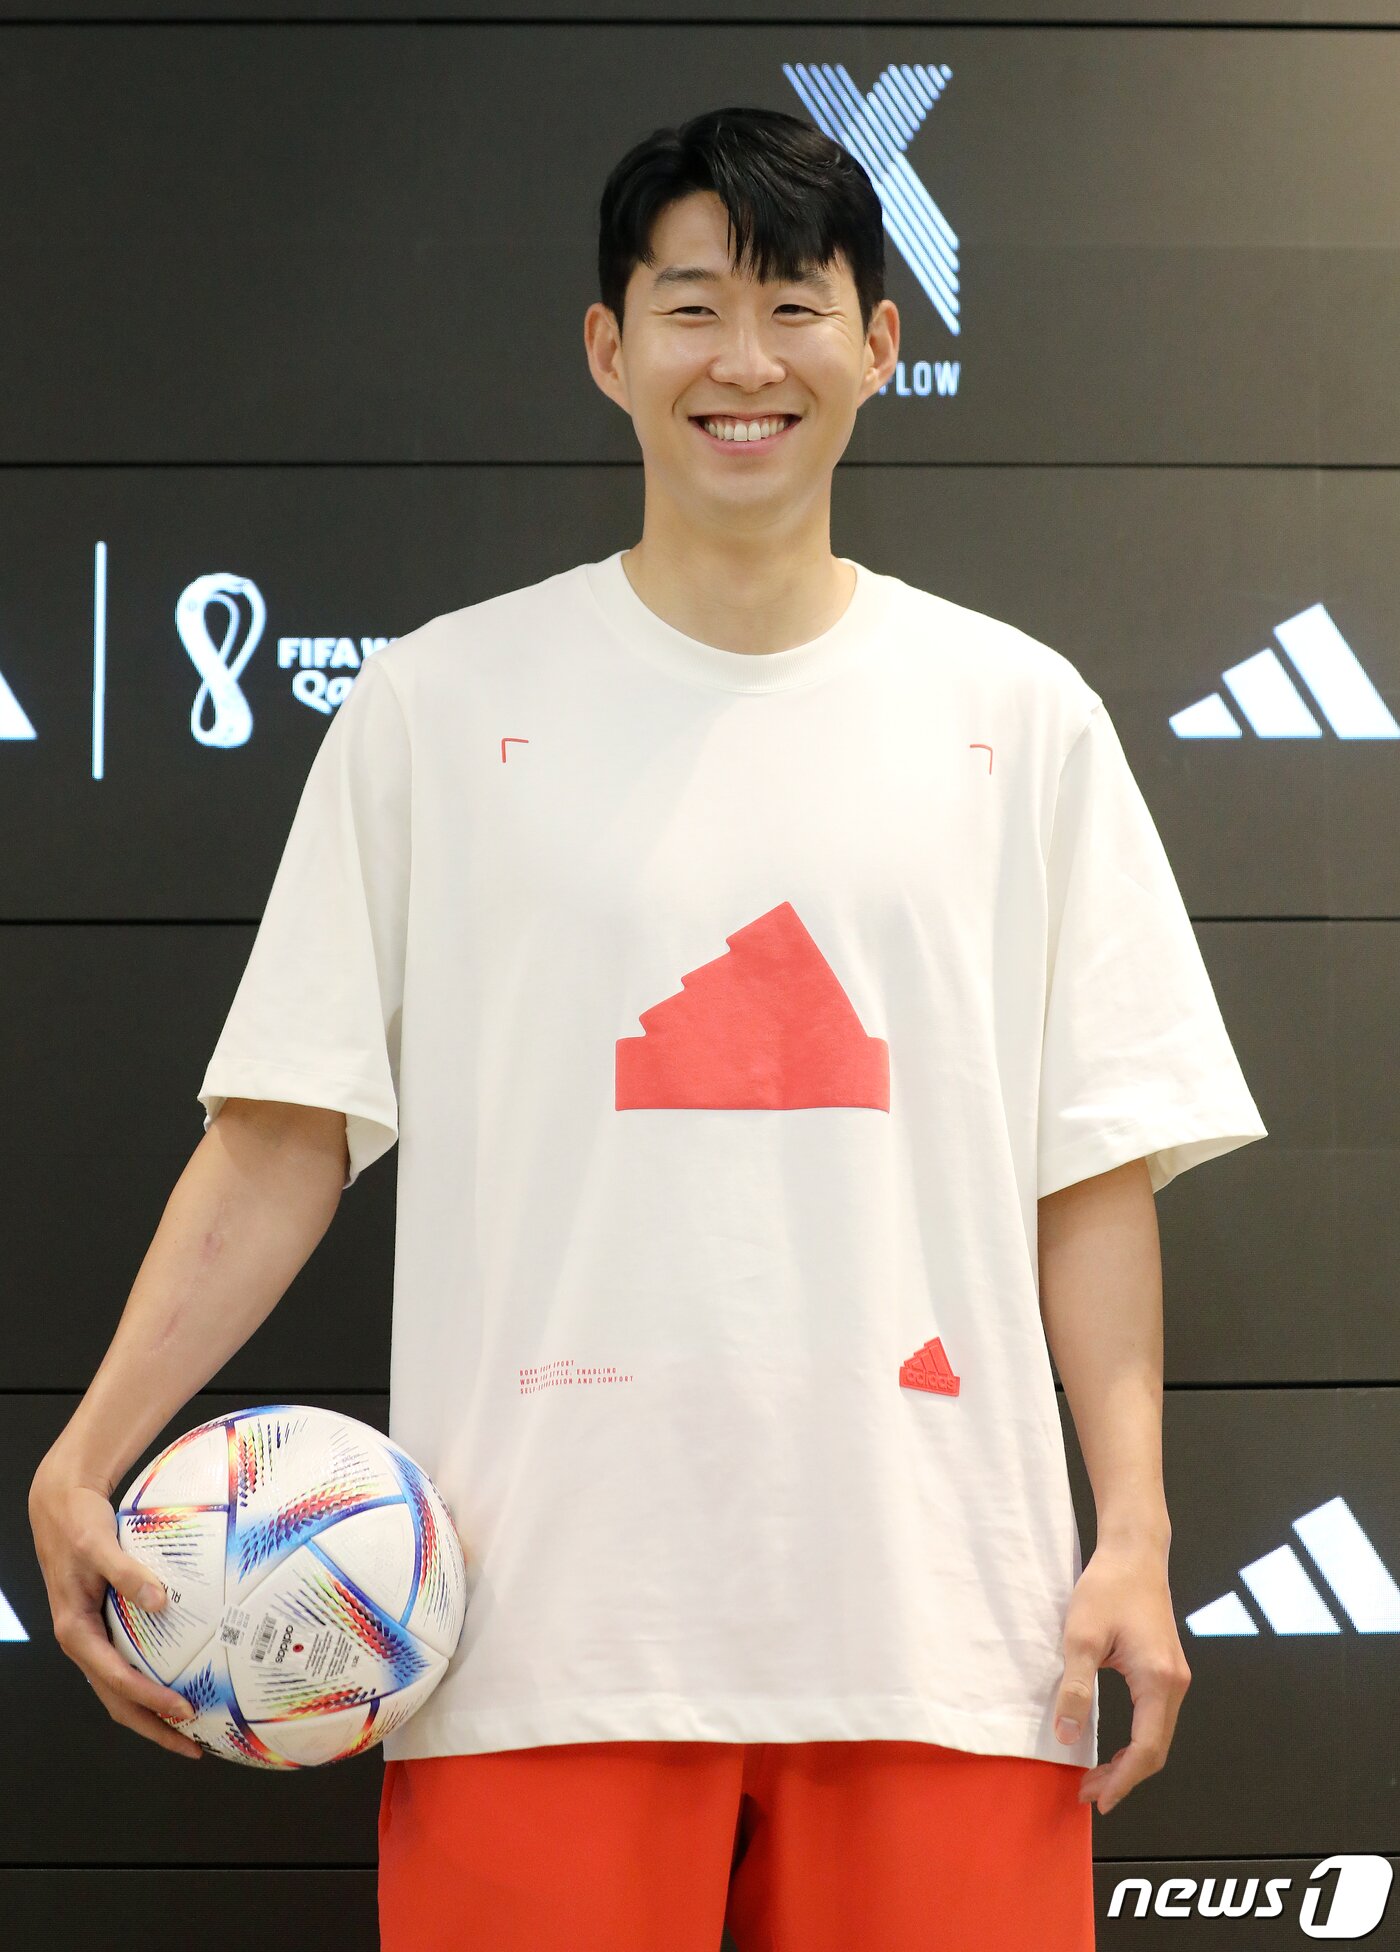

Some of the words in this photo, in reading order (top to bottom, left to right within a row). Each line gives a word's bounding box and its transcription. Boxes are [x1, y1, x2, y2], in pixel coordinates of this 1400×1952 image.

[878, 361, 961, 396] LOW
[277, 637, 361, 669] FIFA
[577, 1377, 593, 1385] AND
[597, 1375, 633, 1384] COMFORT
[904, 1368, 956, 1392] adidas
[275, 1624, 294, 1664] adidas
